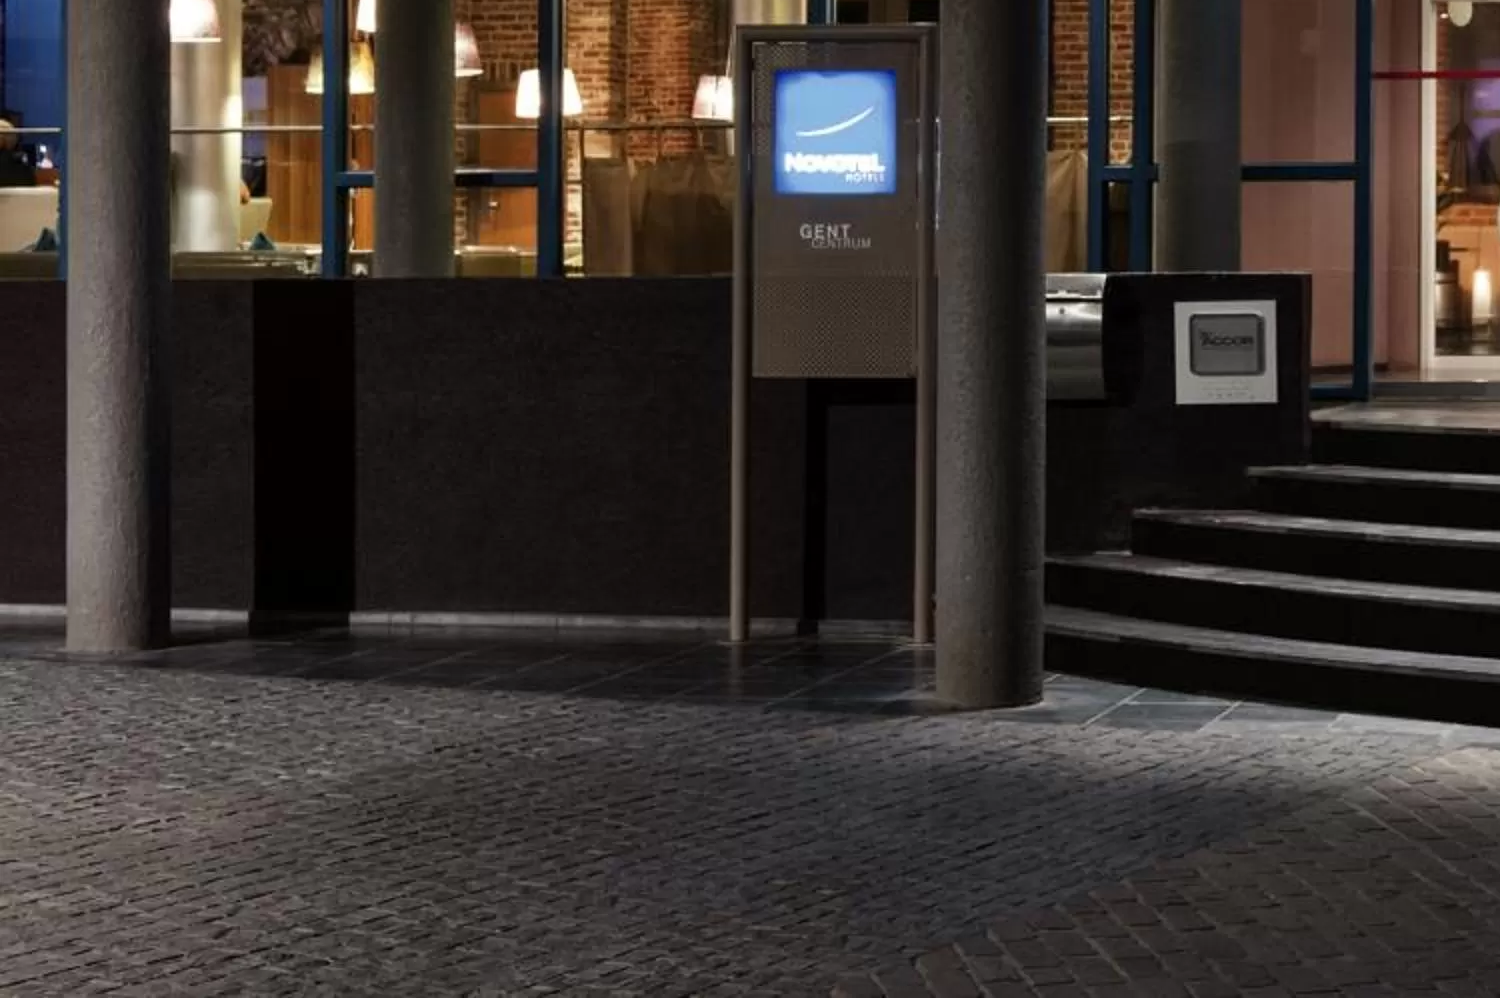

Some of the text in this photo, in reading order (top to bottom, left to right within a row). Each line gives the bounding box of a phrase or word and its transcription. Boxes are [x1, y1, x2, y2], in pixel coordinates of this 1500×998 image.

[784, 152, 886, 174] NOVOTEL
[800, 223, 852, 240] GENT
[811, 237, 872, 250] CENTRUM
